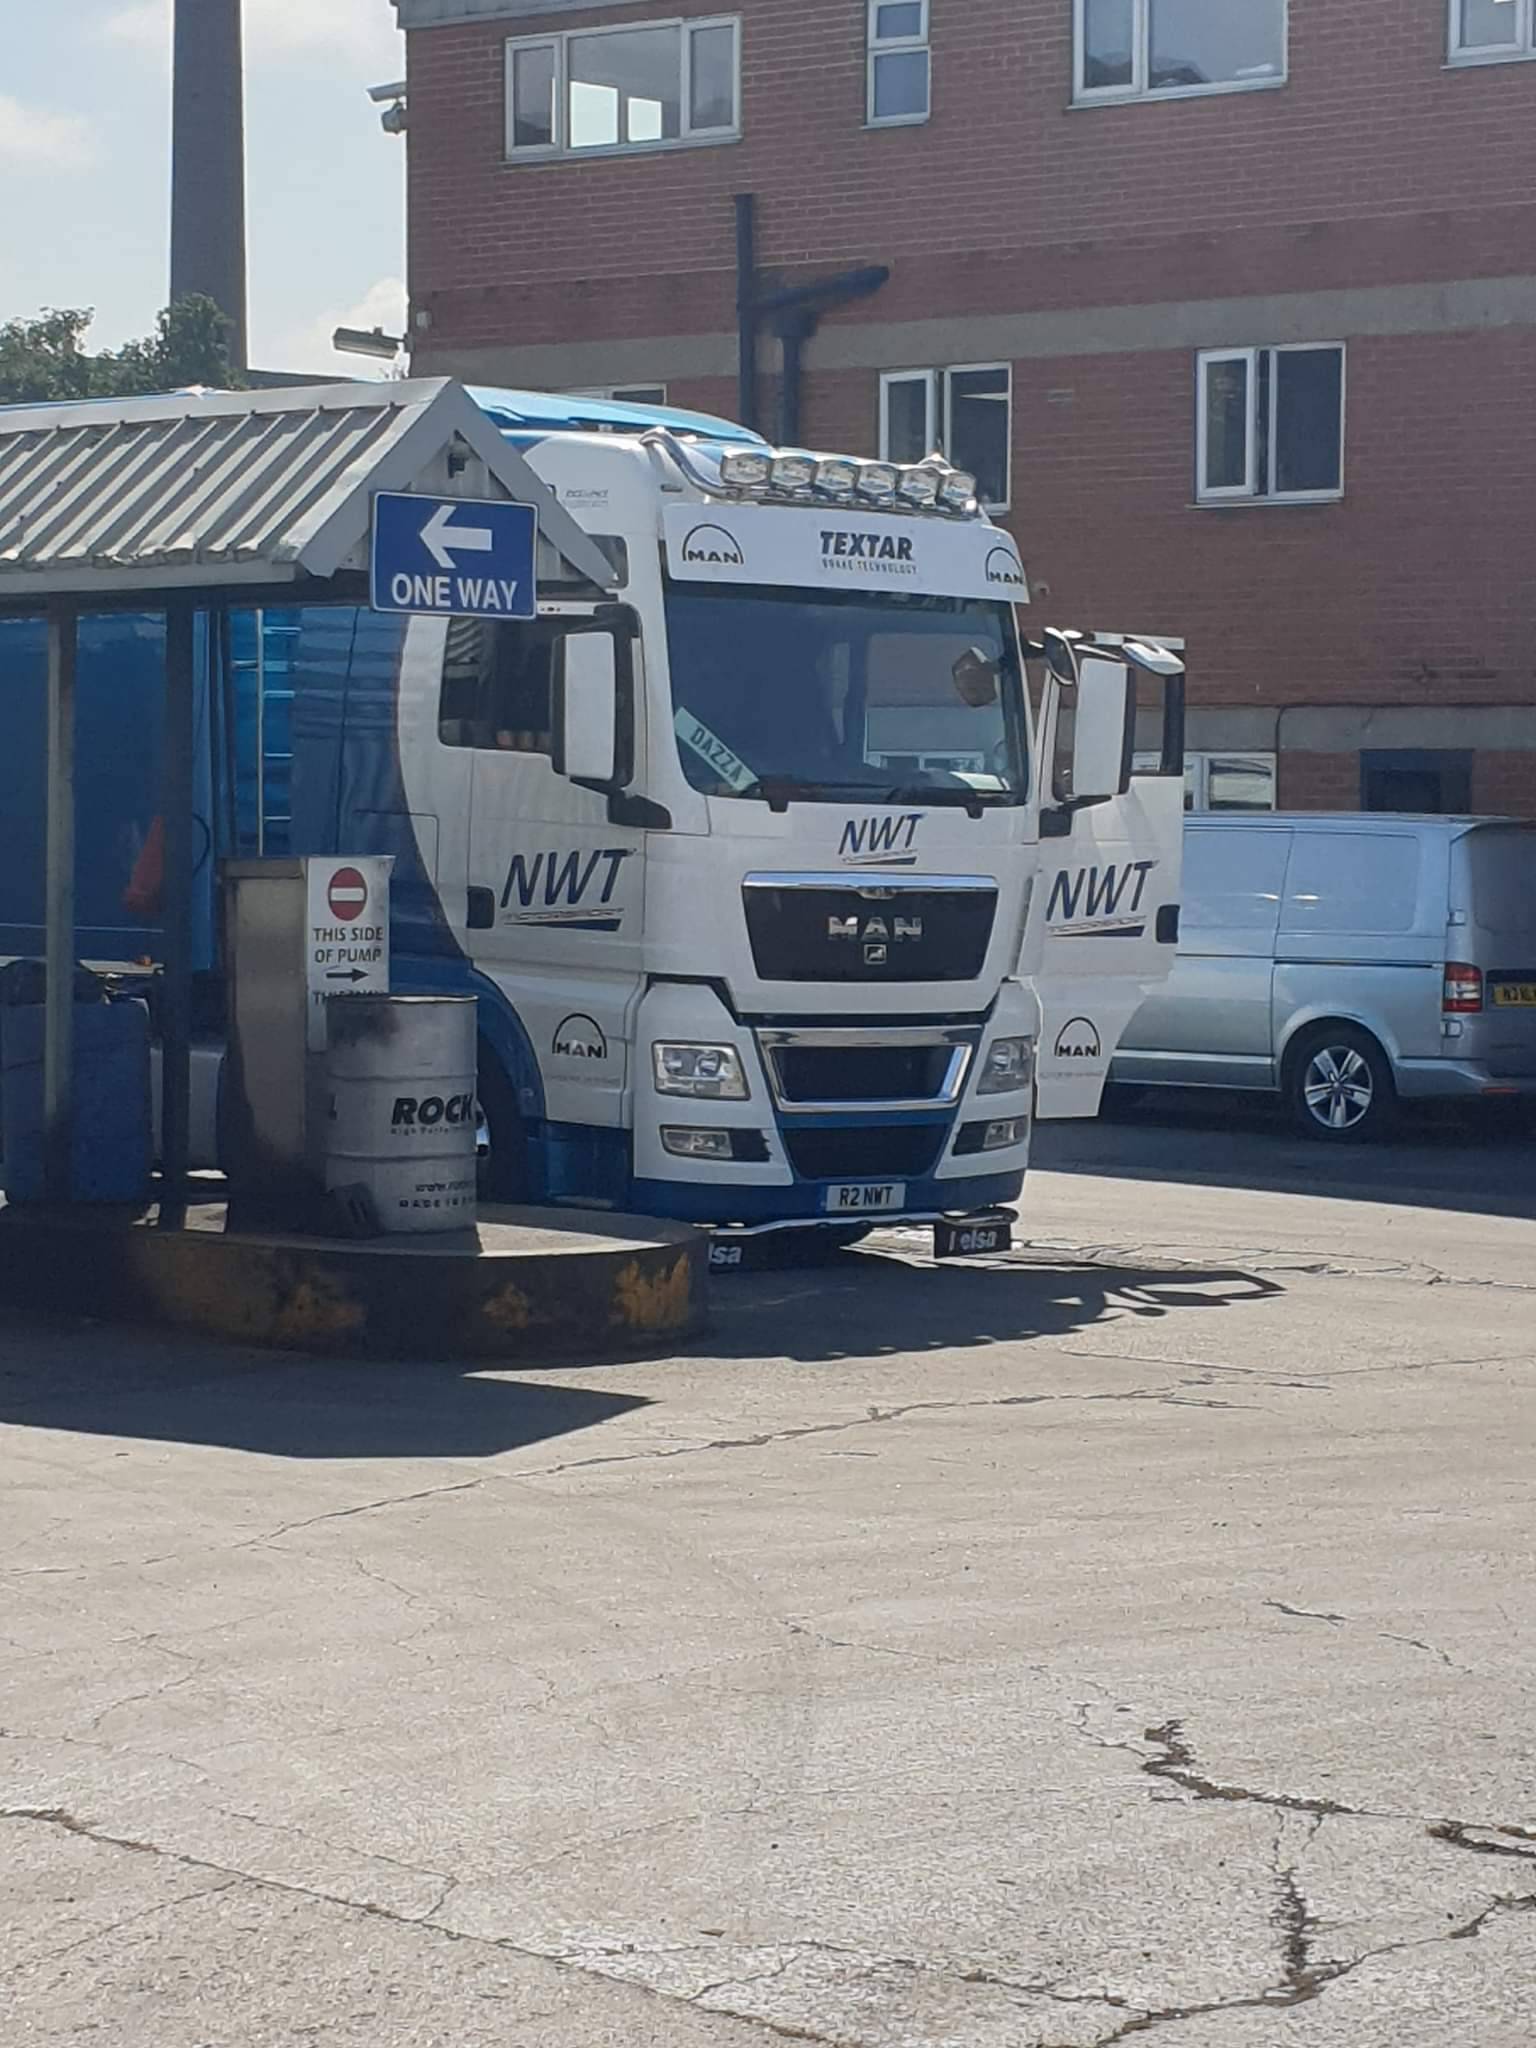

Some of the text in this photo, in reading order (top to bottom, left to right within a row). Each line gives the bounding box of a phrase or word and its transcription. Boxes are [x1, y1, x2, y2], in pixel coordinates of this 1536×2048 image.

[687, 549, 739, 564] MAN
[820, 531, 913, 561] TEXTAR
[989, 571, 1023, 585] MAN
[391, 573, 518, 611] ONE WAY
[690, 727, 744, 782] DAZZA
[838, 812, 926, 855] NWT
[500, 847, 636, 908] NWT
[1045, 859, 1159, 922] NWT
[313, 926, 384, 942] THIS SIDE
[828, 916, 922, 941] MAN
[314, 948, 382, 963] OF PUMP
[556, 1042, 602, 1058] MAN
[1059, 1045, 1097, 1057] MAN
[839, 1186, 894, 1207] R2 NWT
